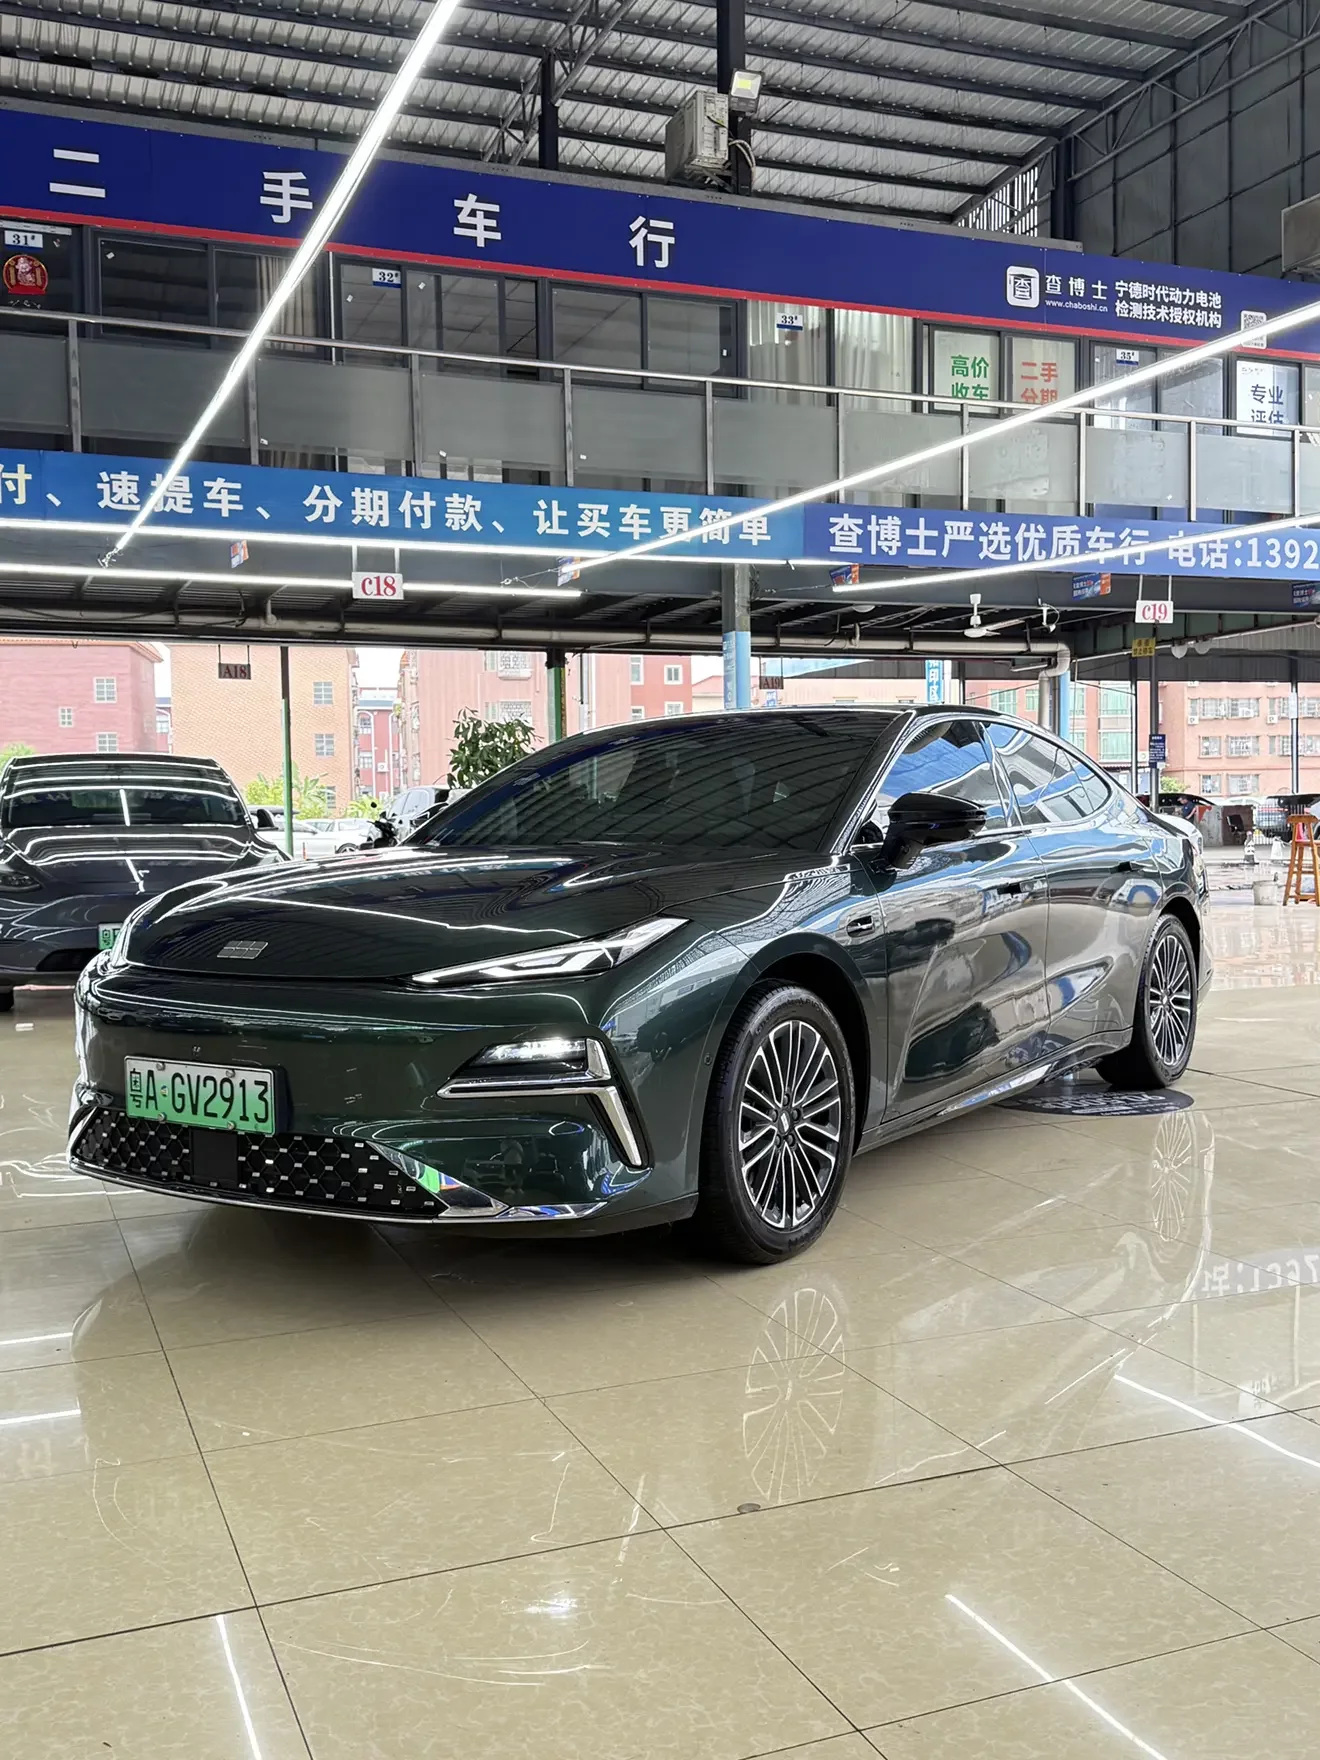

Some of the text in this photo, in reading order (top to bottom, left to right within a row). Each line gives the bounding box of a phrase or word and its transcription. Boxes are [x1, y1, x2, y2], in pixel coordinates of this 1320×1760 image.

[1045, 274, 1108, 300] 查博士
[1115, 280, 1221, 309] 宁德时代动力电池
[1045, 299, 1108, 313] www.chaboshi.cn
[1115, 300, 1222, 328] 检测技术授权机构
[950, 354, 989, 378] 高价
[1021, 361, 1058, 383] 二手
[1250, 384, 1284, 405] 专业
[828, 513, 1150, 565] 查博士严选优质车行
[361, 575, 397, 597] C18
[1142, 603, 1168, 620] C19
